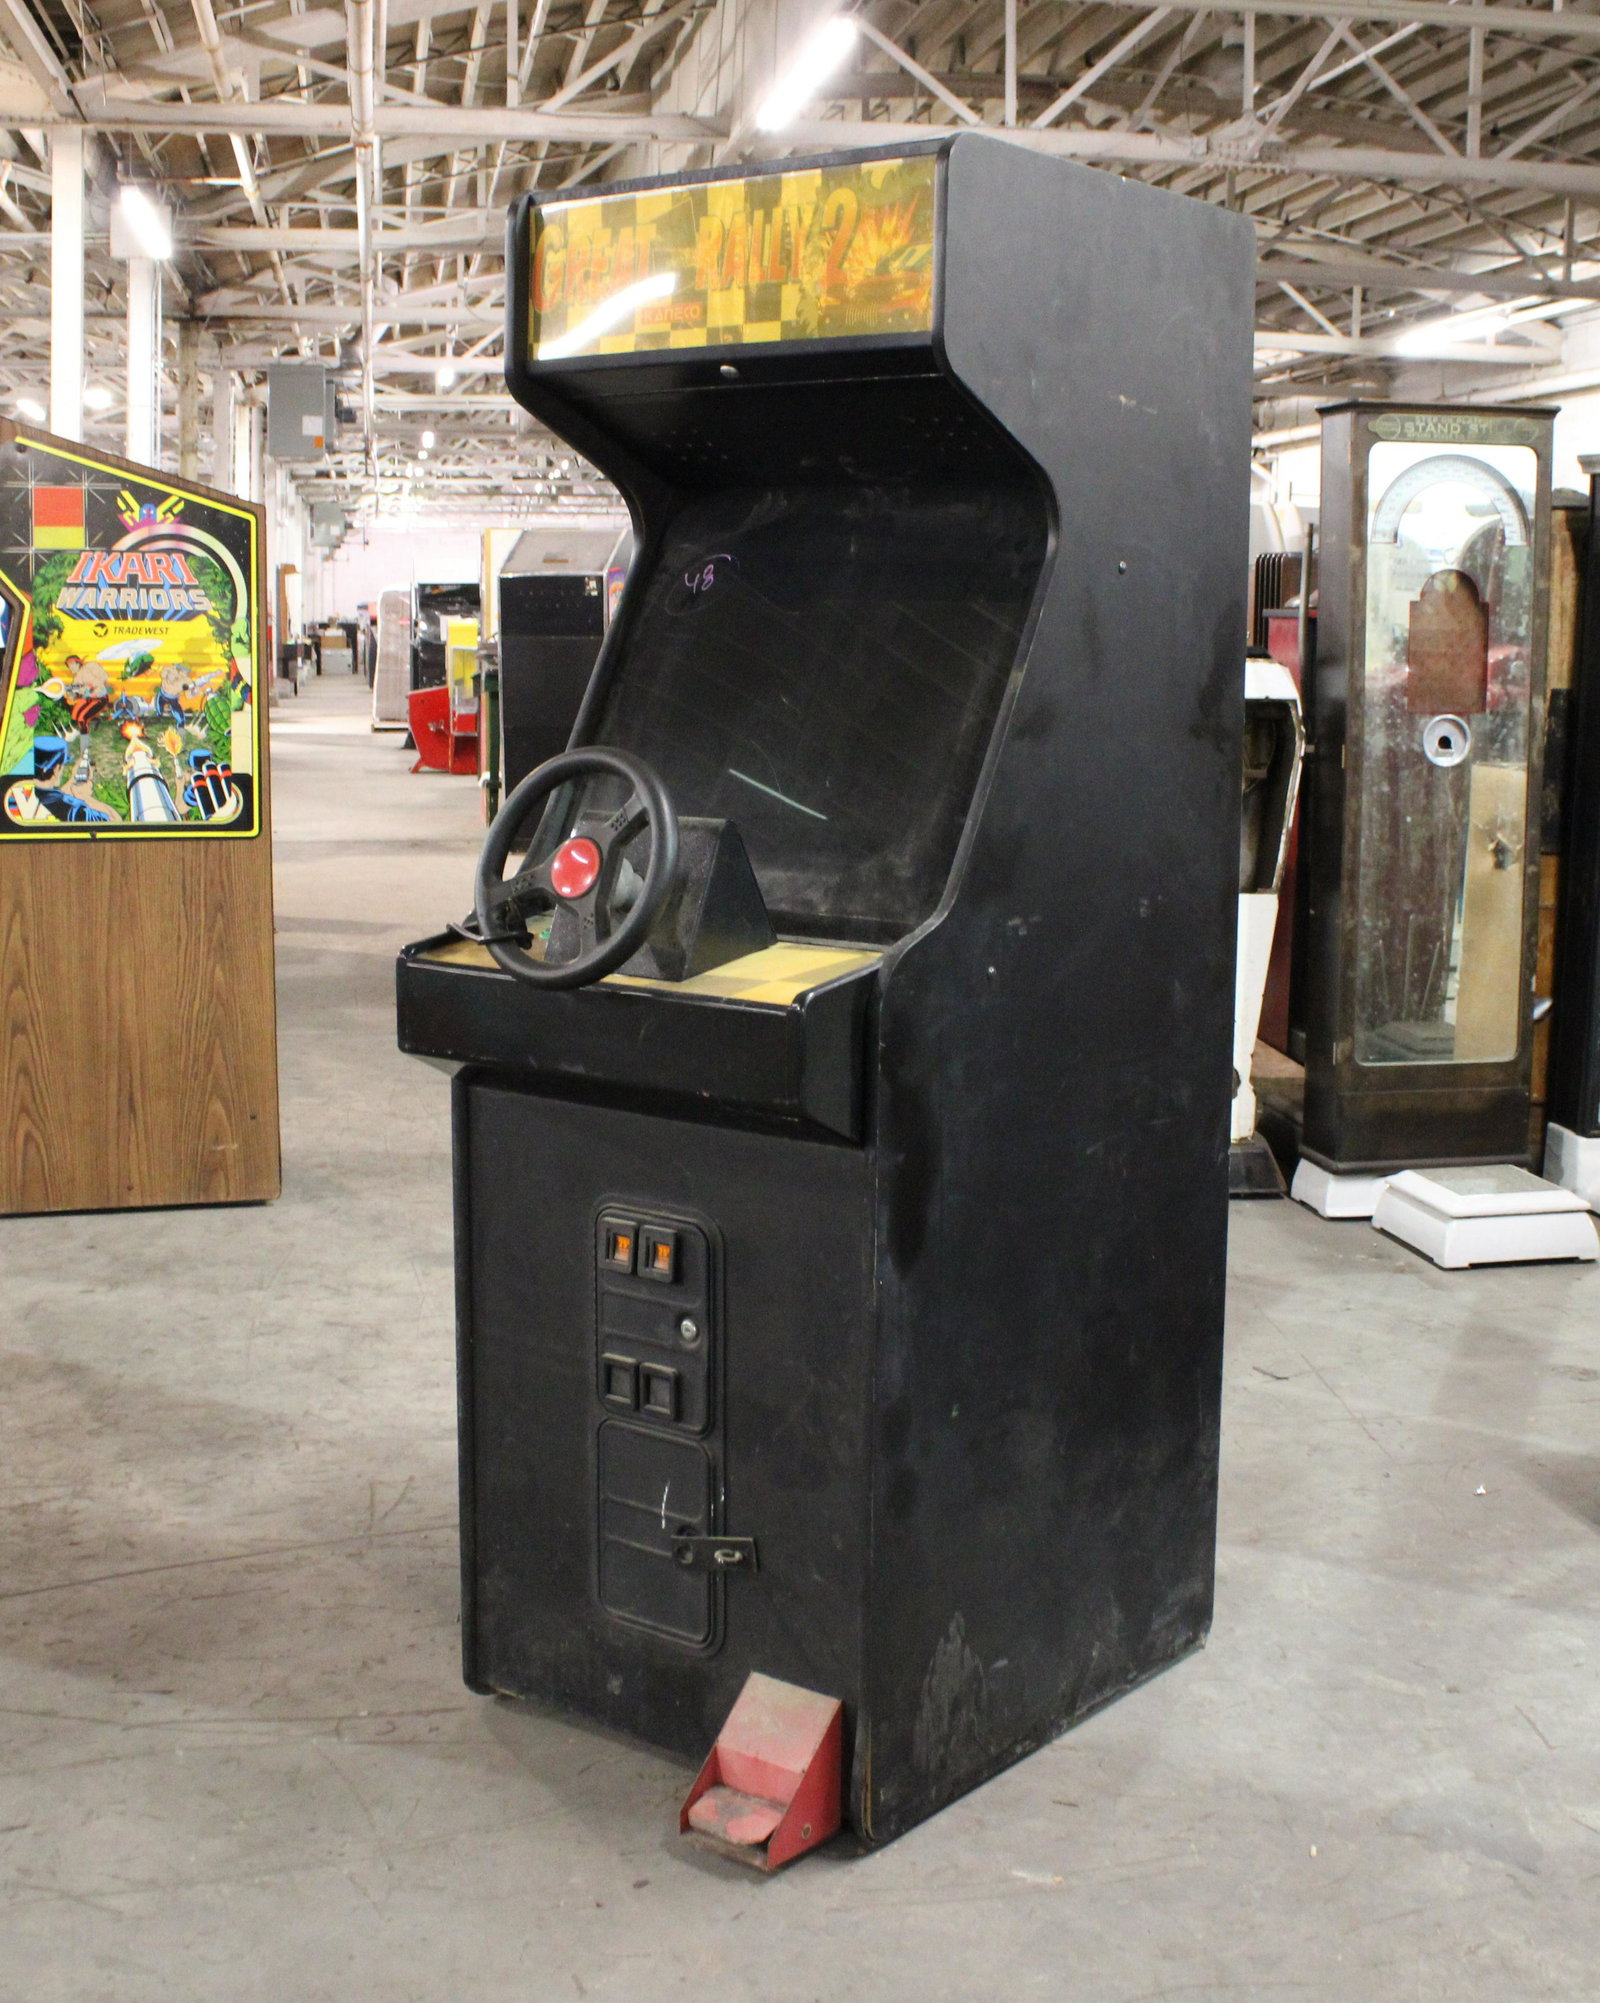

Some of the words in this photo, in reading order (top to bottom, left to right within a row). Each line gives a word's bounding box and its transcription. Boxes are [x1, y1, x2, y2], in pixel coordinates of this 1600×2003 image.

[532, 222, 658, 313] GREAT
[695, 203, 815, 291] RALLY
[817, 186, 859, 301] 2
[1404, 422, 1461, 434] STAND
[66, 551, 199, 585] IKARI
[684, 563, 714, 594] 48
[56, 586, 213, 612] WARRIORS
[113, 626, 169, 636] TRADEWEST
